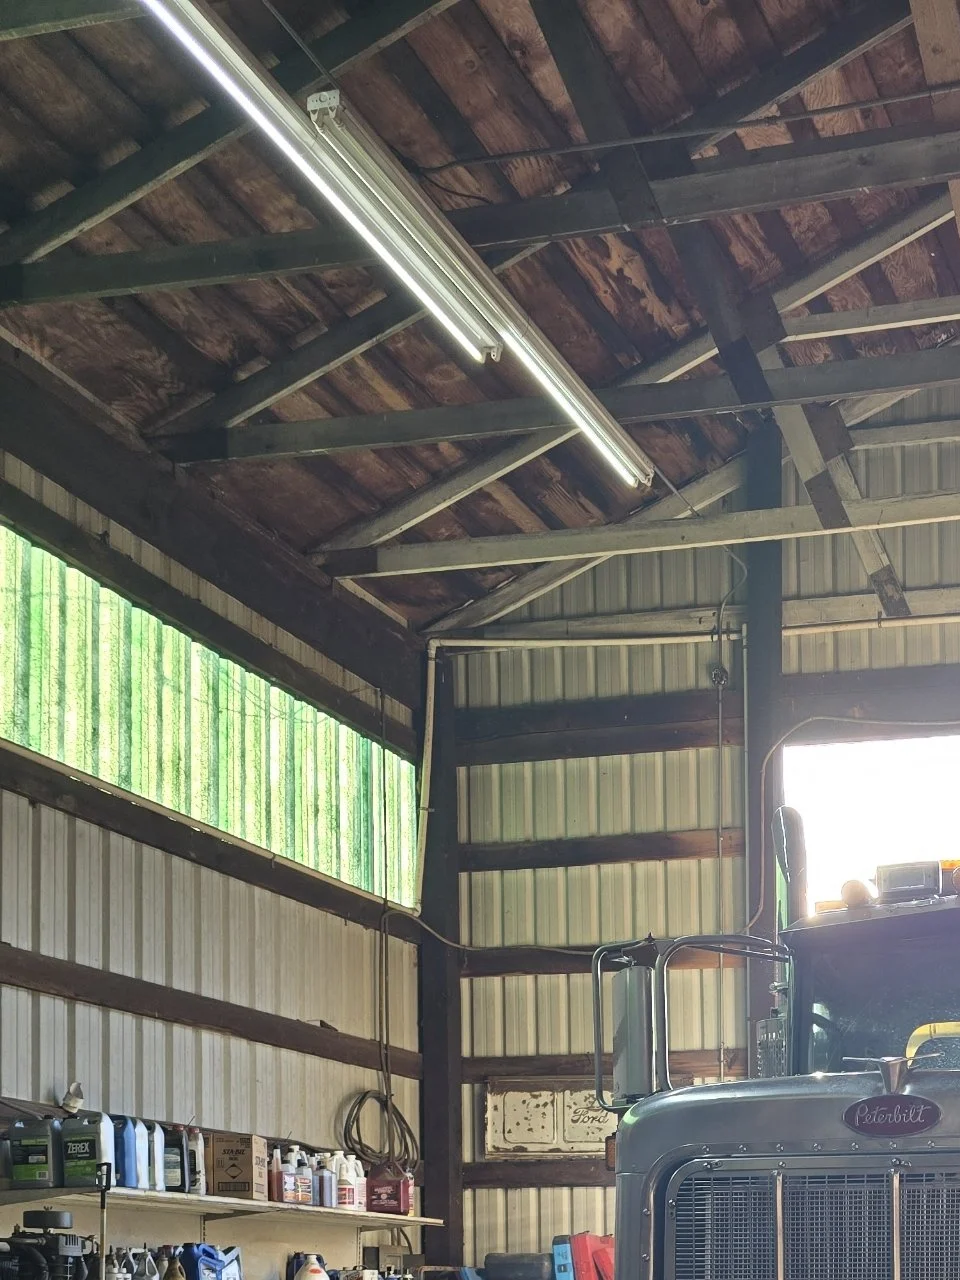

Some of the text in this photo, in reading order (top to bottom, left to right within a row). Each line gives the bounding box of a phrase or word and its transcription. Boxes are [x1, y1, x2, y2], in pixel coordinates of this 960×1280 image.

[571, 1107, 610, 1124] Ford
[854, 1103, 932, 1126] Peterbilt
[67, 1142, 90, 1154] ZEREX
